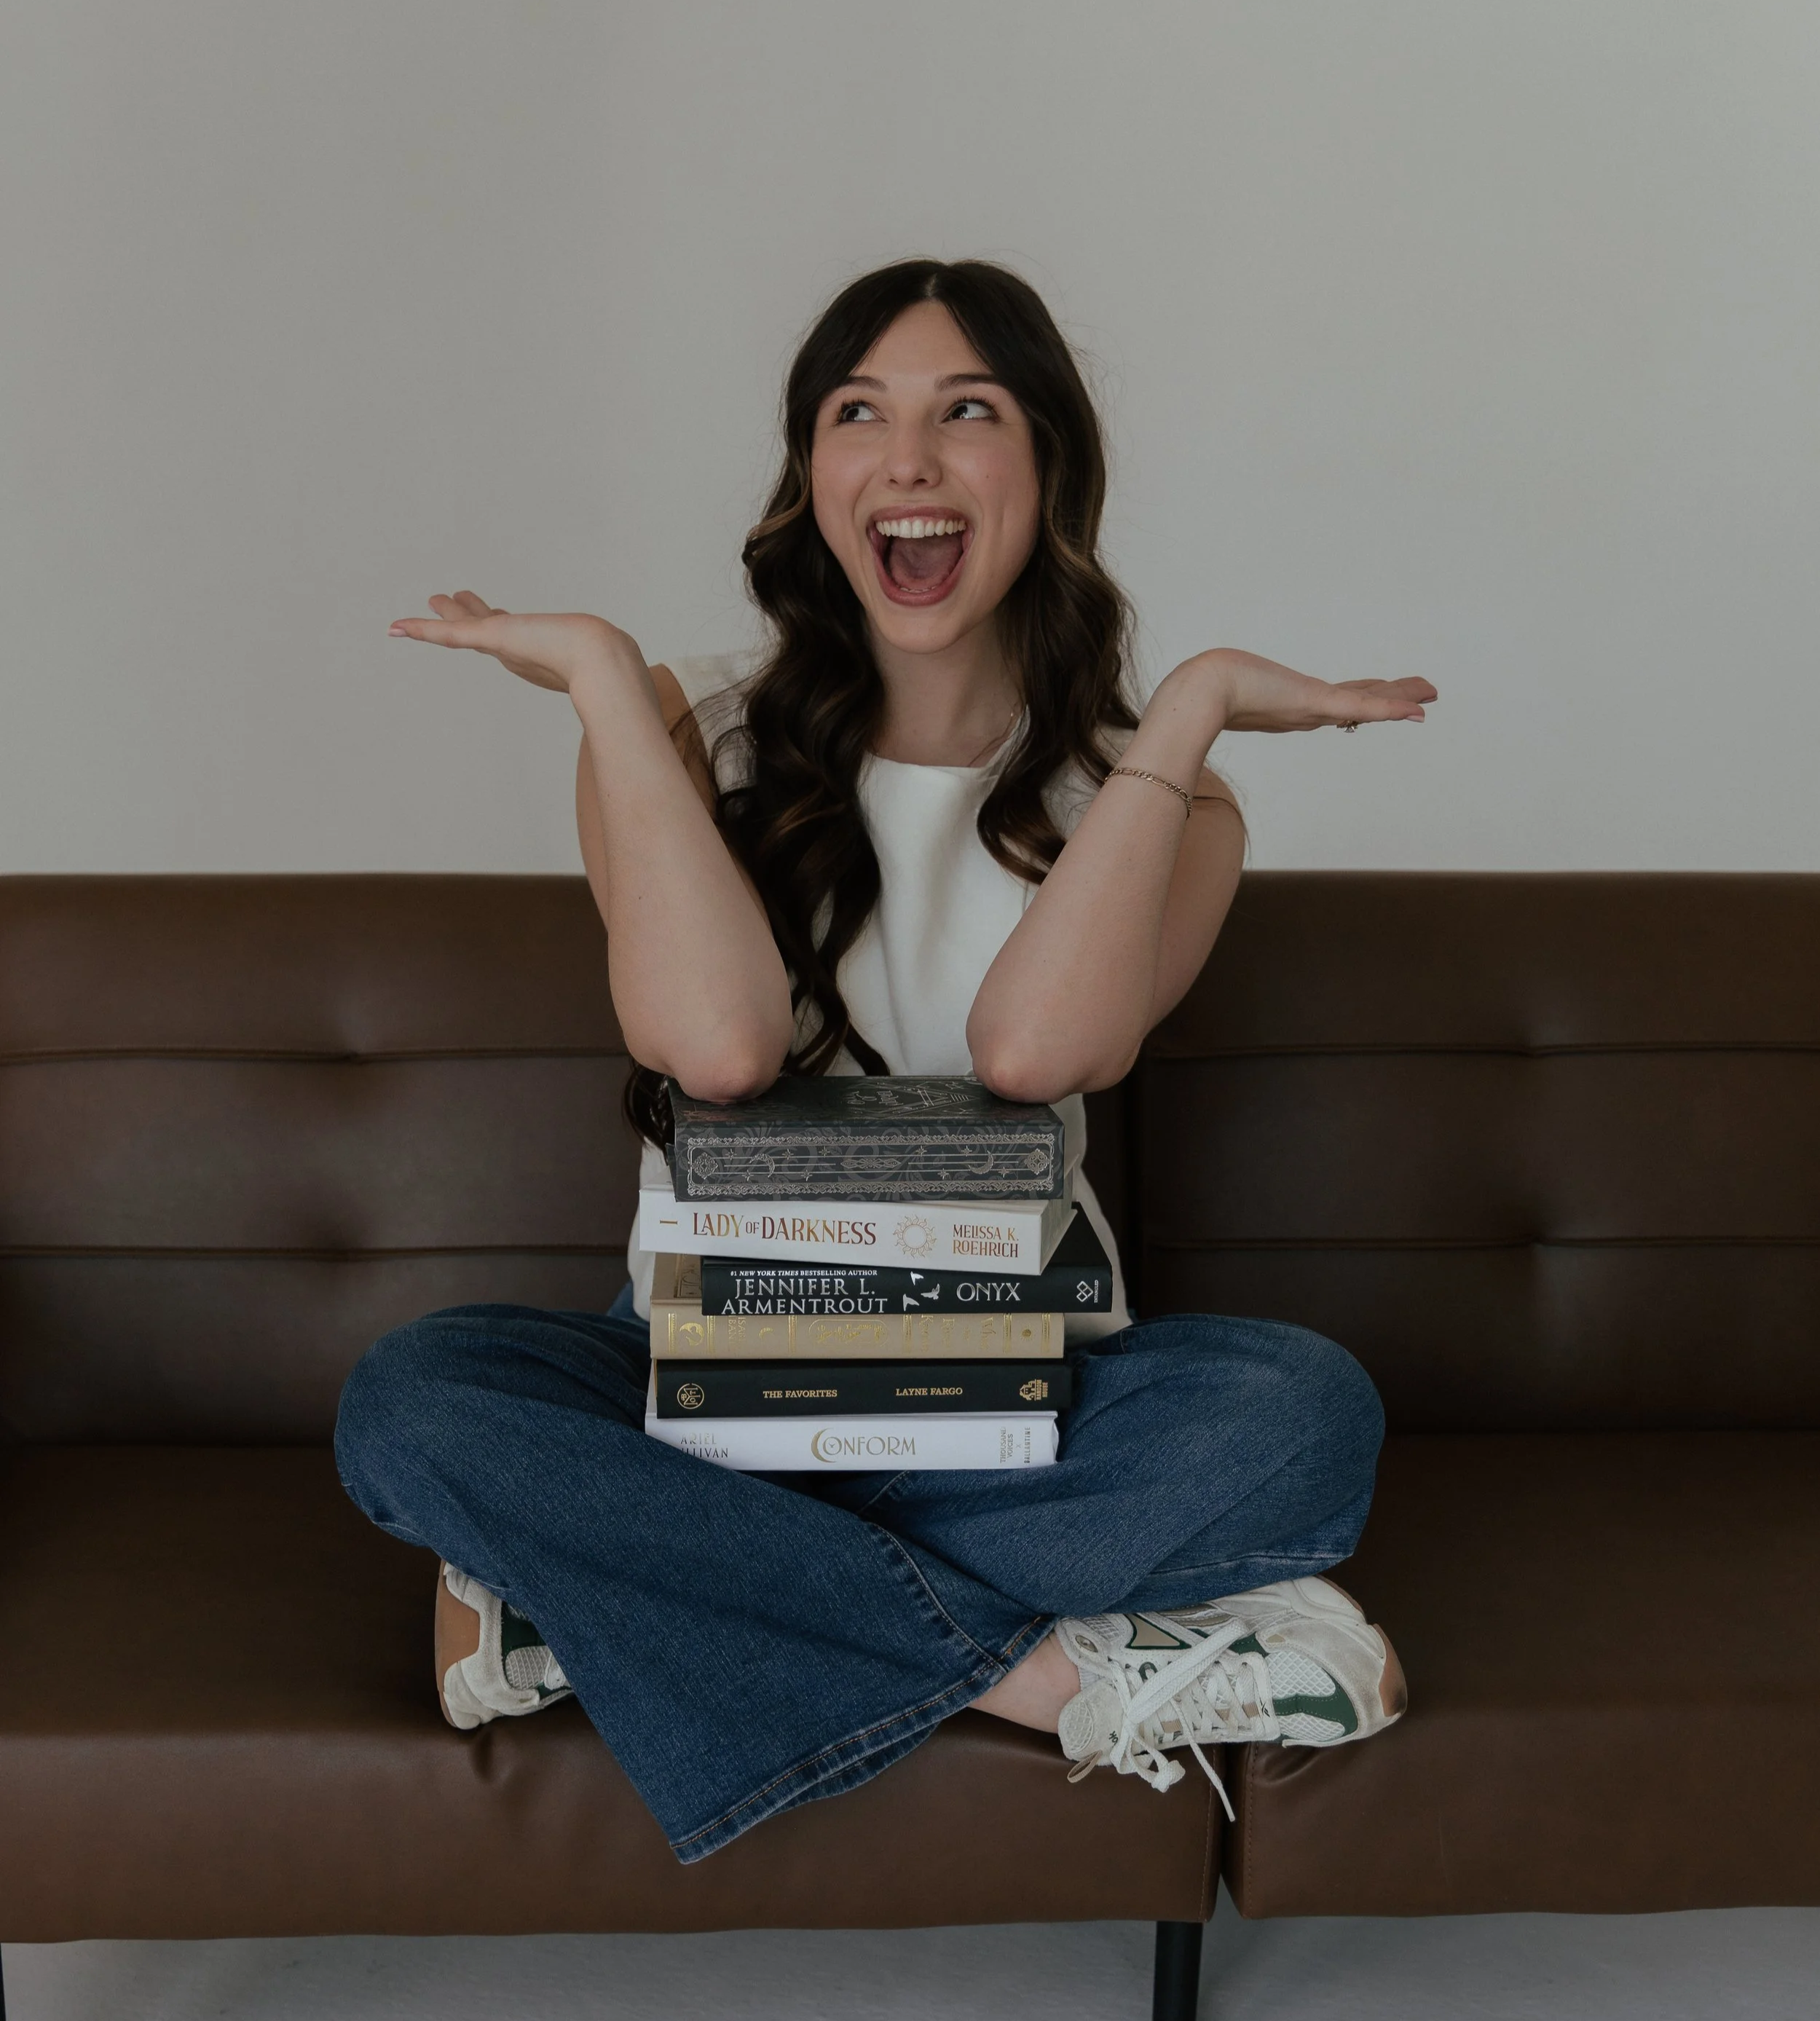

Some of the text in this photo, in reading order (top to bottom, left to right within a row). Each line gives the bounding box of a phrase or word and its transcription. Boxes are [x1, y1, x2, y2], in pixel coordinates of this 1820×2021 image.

[693, 1212, 877, 1245] LADY OF DARKNESS
[953, 1224, 1019, 1241] MELISSA K.
[953, 1239, 1019, 1258] ROEHRICH
[734, 1278, 875, 1299] JENNIFER L.
[956, 1282, 1021, 1301] ONYX
[721, 1298, 888, 1315] ARMENTROUT
[763, 1389, 838, 1399] THE FAVORITES
[895, 1387, 964, 1396] LAYNE FARGO
[680, 1432, 717, 1446] ARIEL
[811, 1427, 916, 1463] CONFORM
